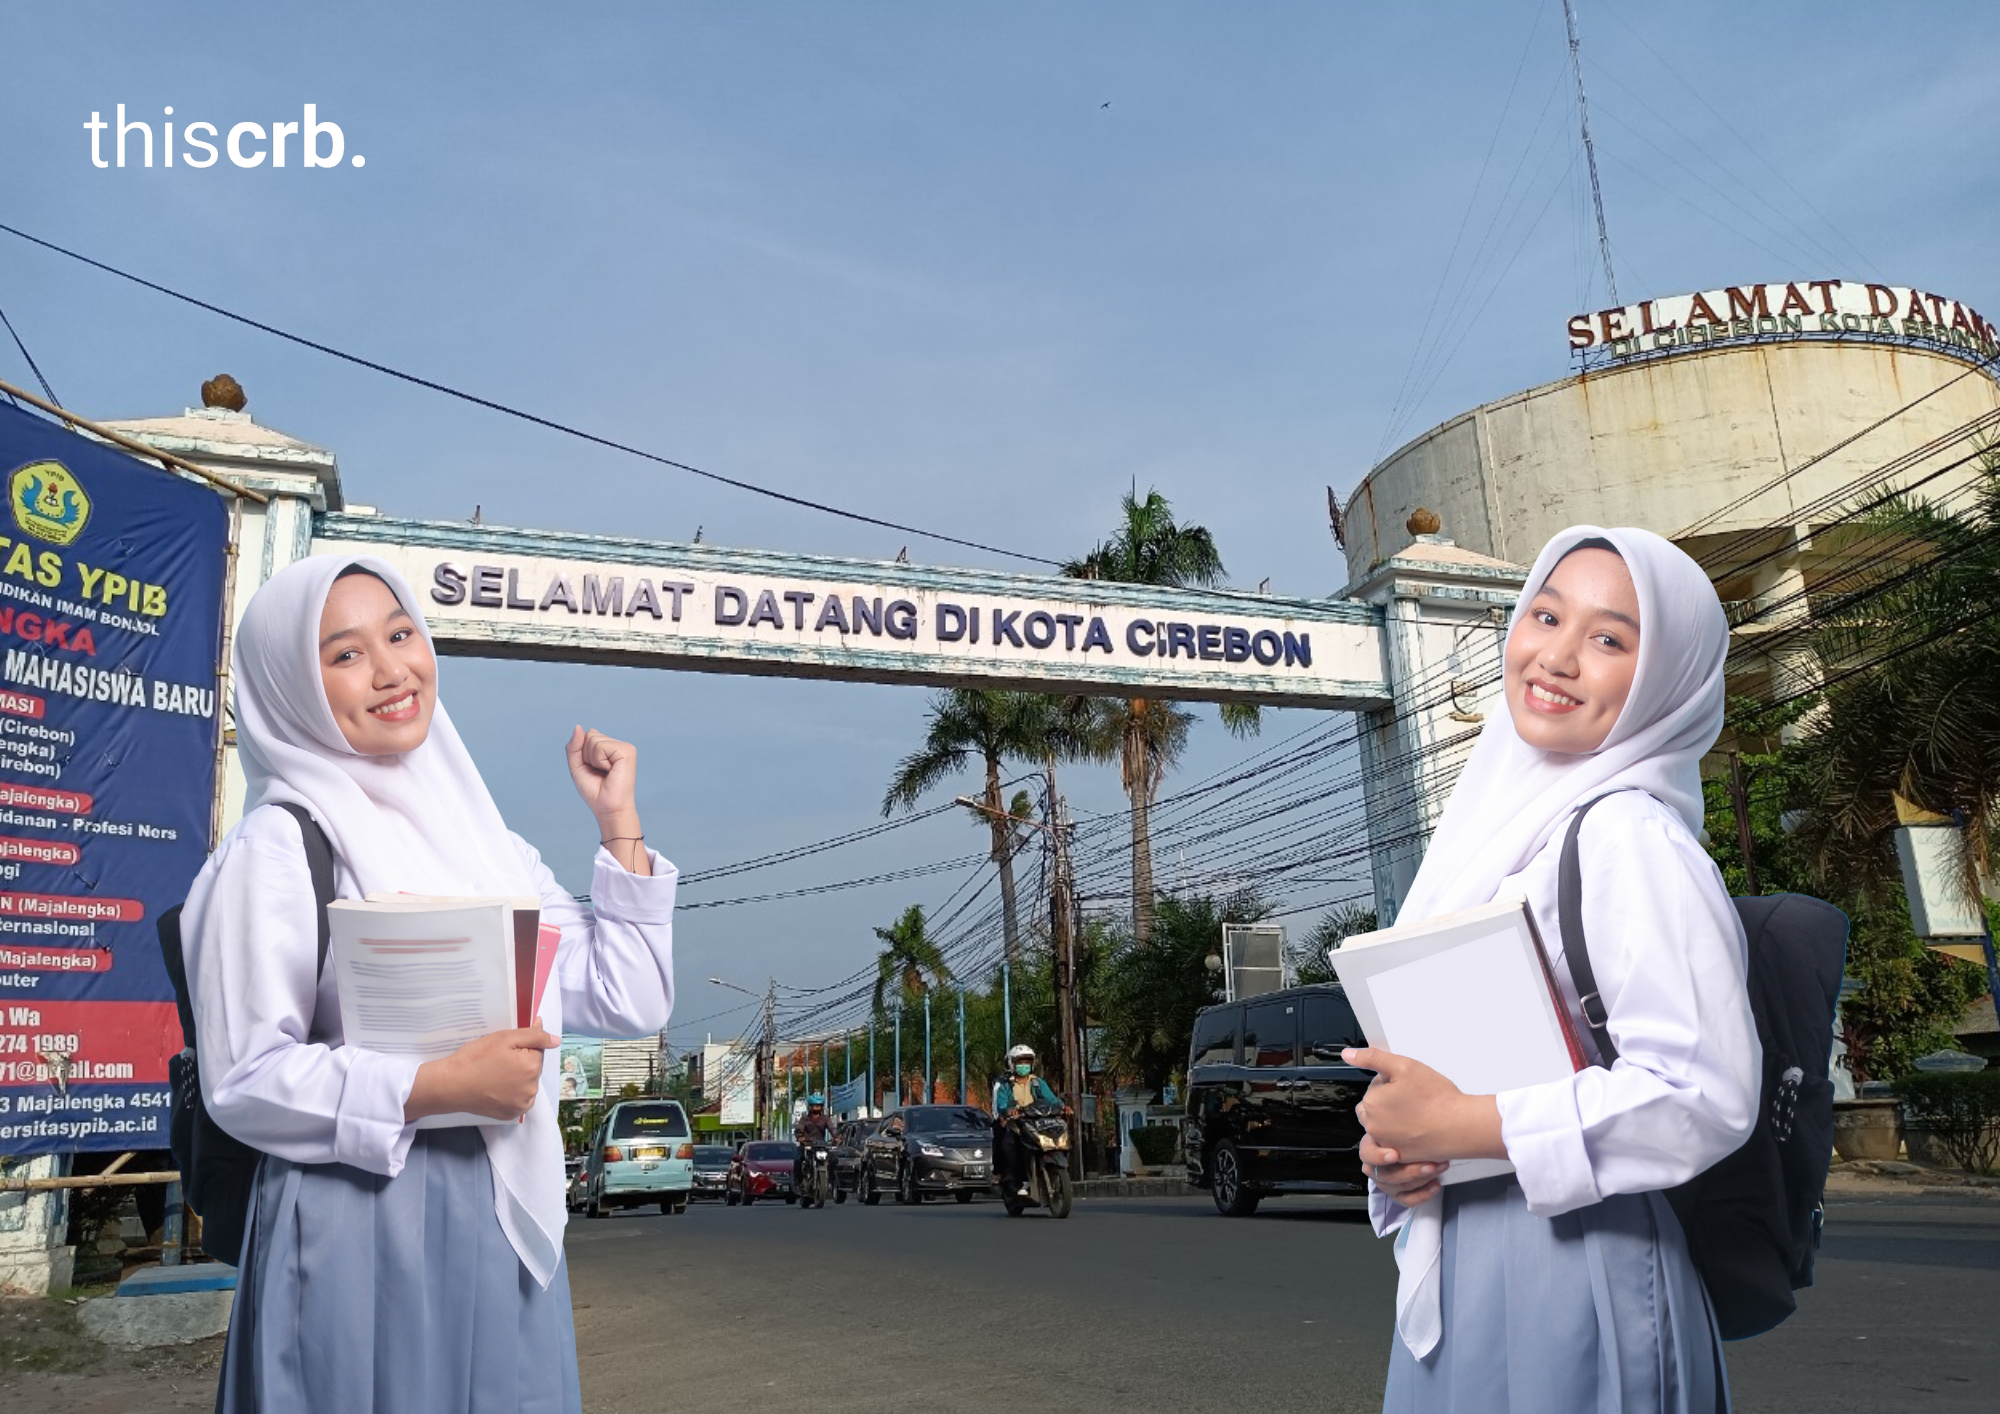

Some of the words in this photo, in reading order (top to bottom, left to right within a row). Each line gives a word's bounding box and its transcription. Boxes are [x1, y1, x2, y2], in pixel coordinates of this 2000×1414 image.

[1568, 280, 1841, 349] SELAMAT
[1611, 336, 1640, 358] DI
[1653, 314, 1802, 350] CIREBON
[1818, 311, 1896, 335] KOTA
[77, 562, 167, 617] YPIB
[56, 599, 97, 621] IMAM
[430, 562, 694, 621] SELAMAT
[714, 585, 918, 640] DATANG
[936, 603, 980, 644] DI
[993, 608, 1113, 653] KOTA
[1126, 619, 1312, 667] CIREBON
[4, 649, 147, 708] MAHASISWA
[153, 680, 214, 719] BARU
[0, 842, 77, 864] jalengka)
[18, 898, 121, 919] (Majalengka)
[0, 918, 95, 936] ernasional
[0, 973, 40, 988] uter
[9, 1007, 41, 1026] Wa
[31, 1034, 79, 1053] 1989
[16, 1094, 126, 1115] Majalengka
[130, 1092, 172, 1108] 4541
[0, 1115, 158, 1139] ersitasypib.ac.id
